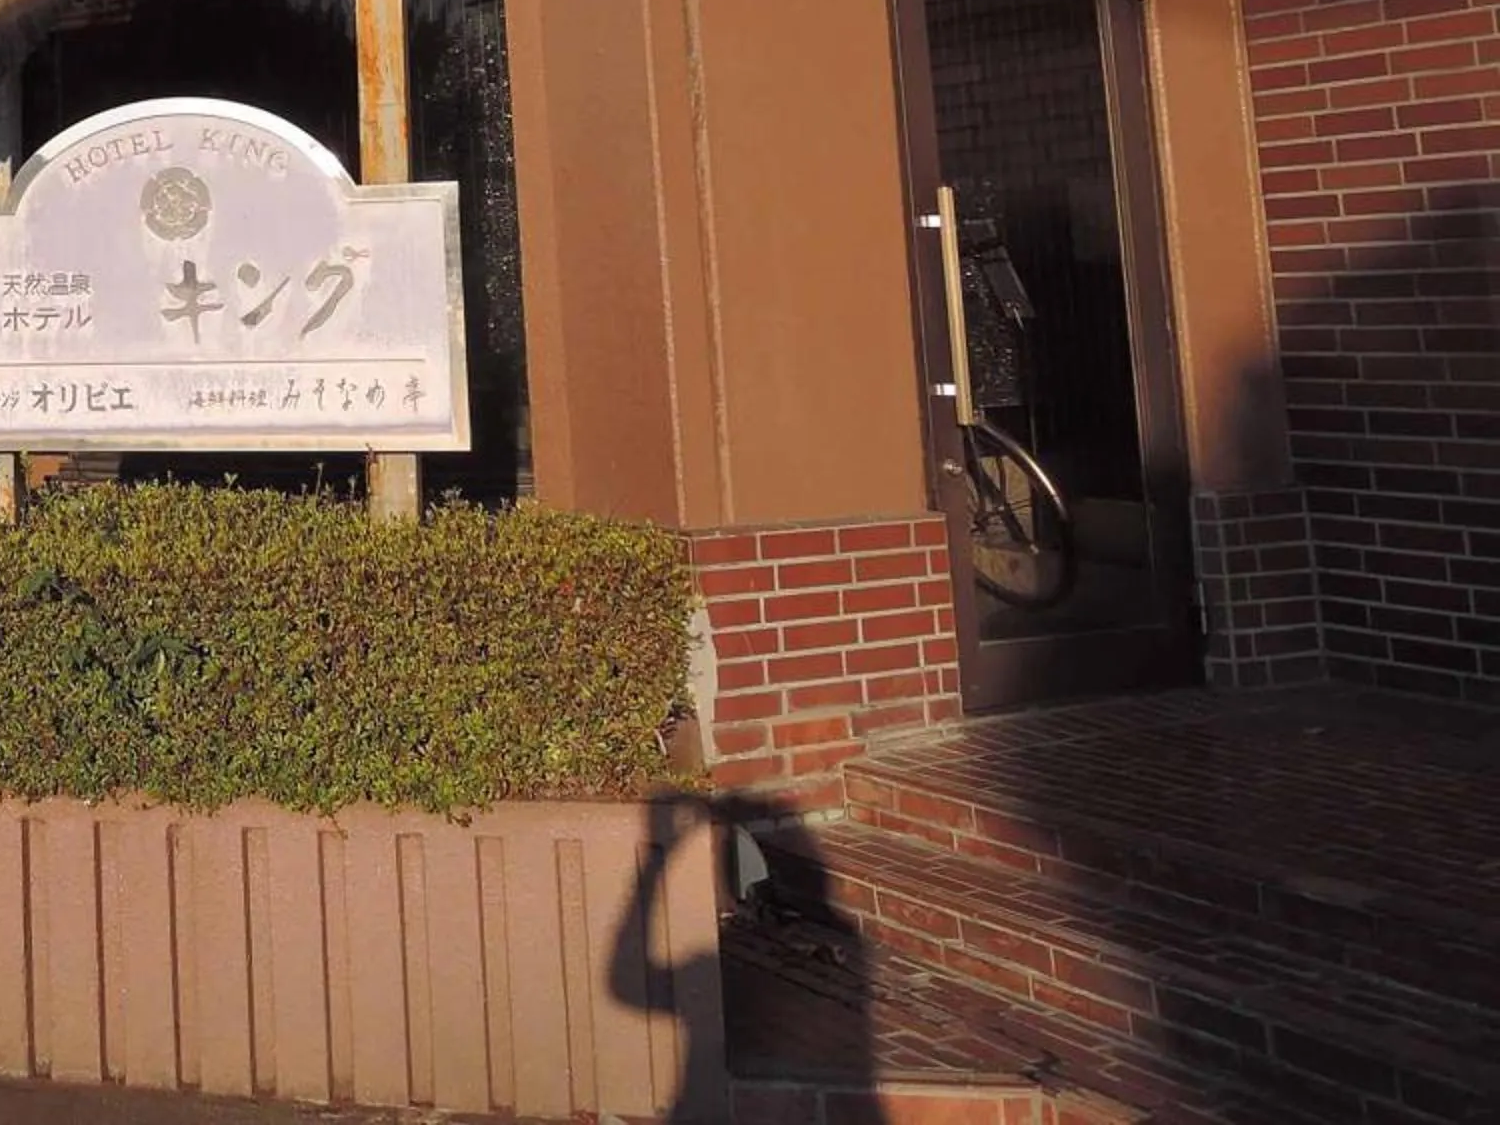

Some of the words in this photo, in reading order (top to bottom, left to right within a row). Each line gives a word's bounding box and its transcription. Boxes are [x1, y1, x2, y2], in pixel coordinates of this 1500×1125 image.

[64, 130, 174, 184] HOTEL
[199, 128, 290, 172] KING
[3, 273, 92, 296] 天然温泉
[160, 246, 369, 343] キング
[3, 305, 92, 331] ホテル
